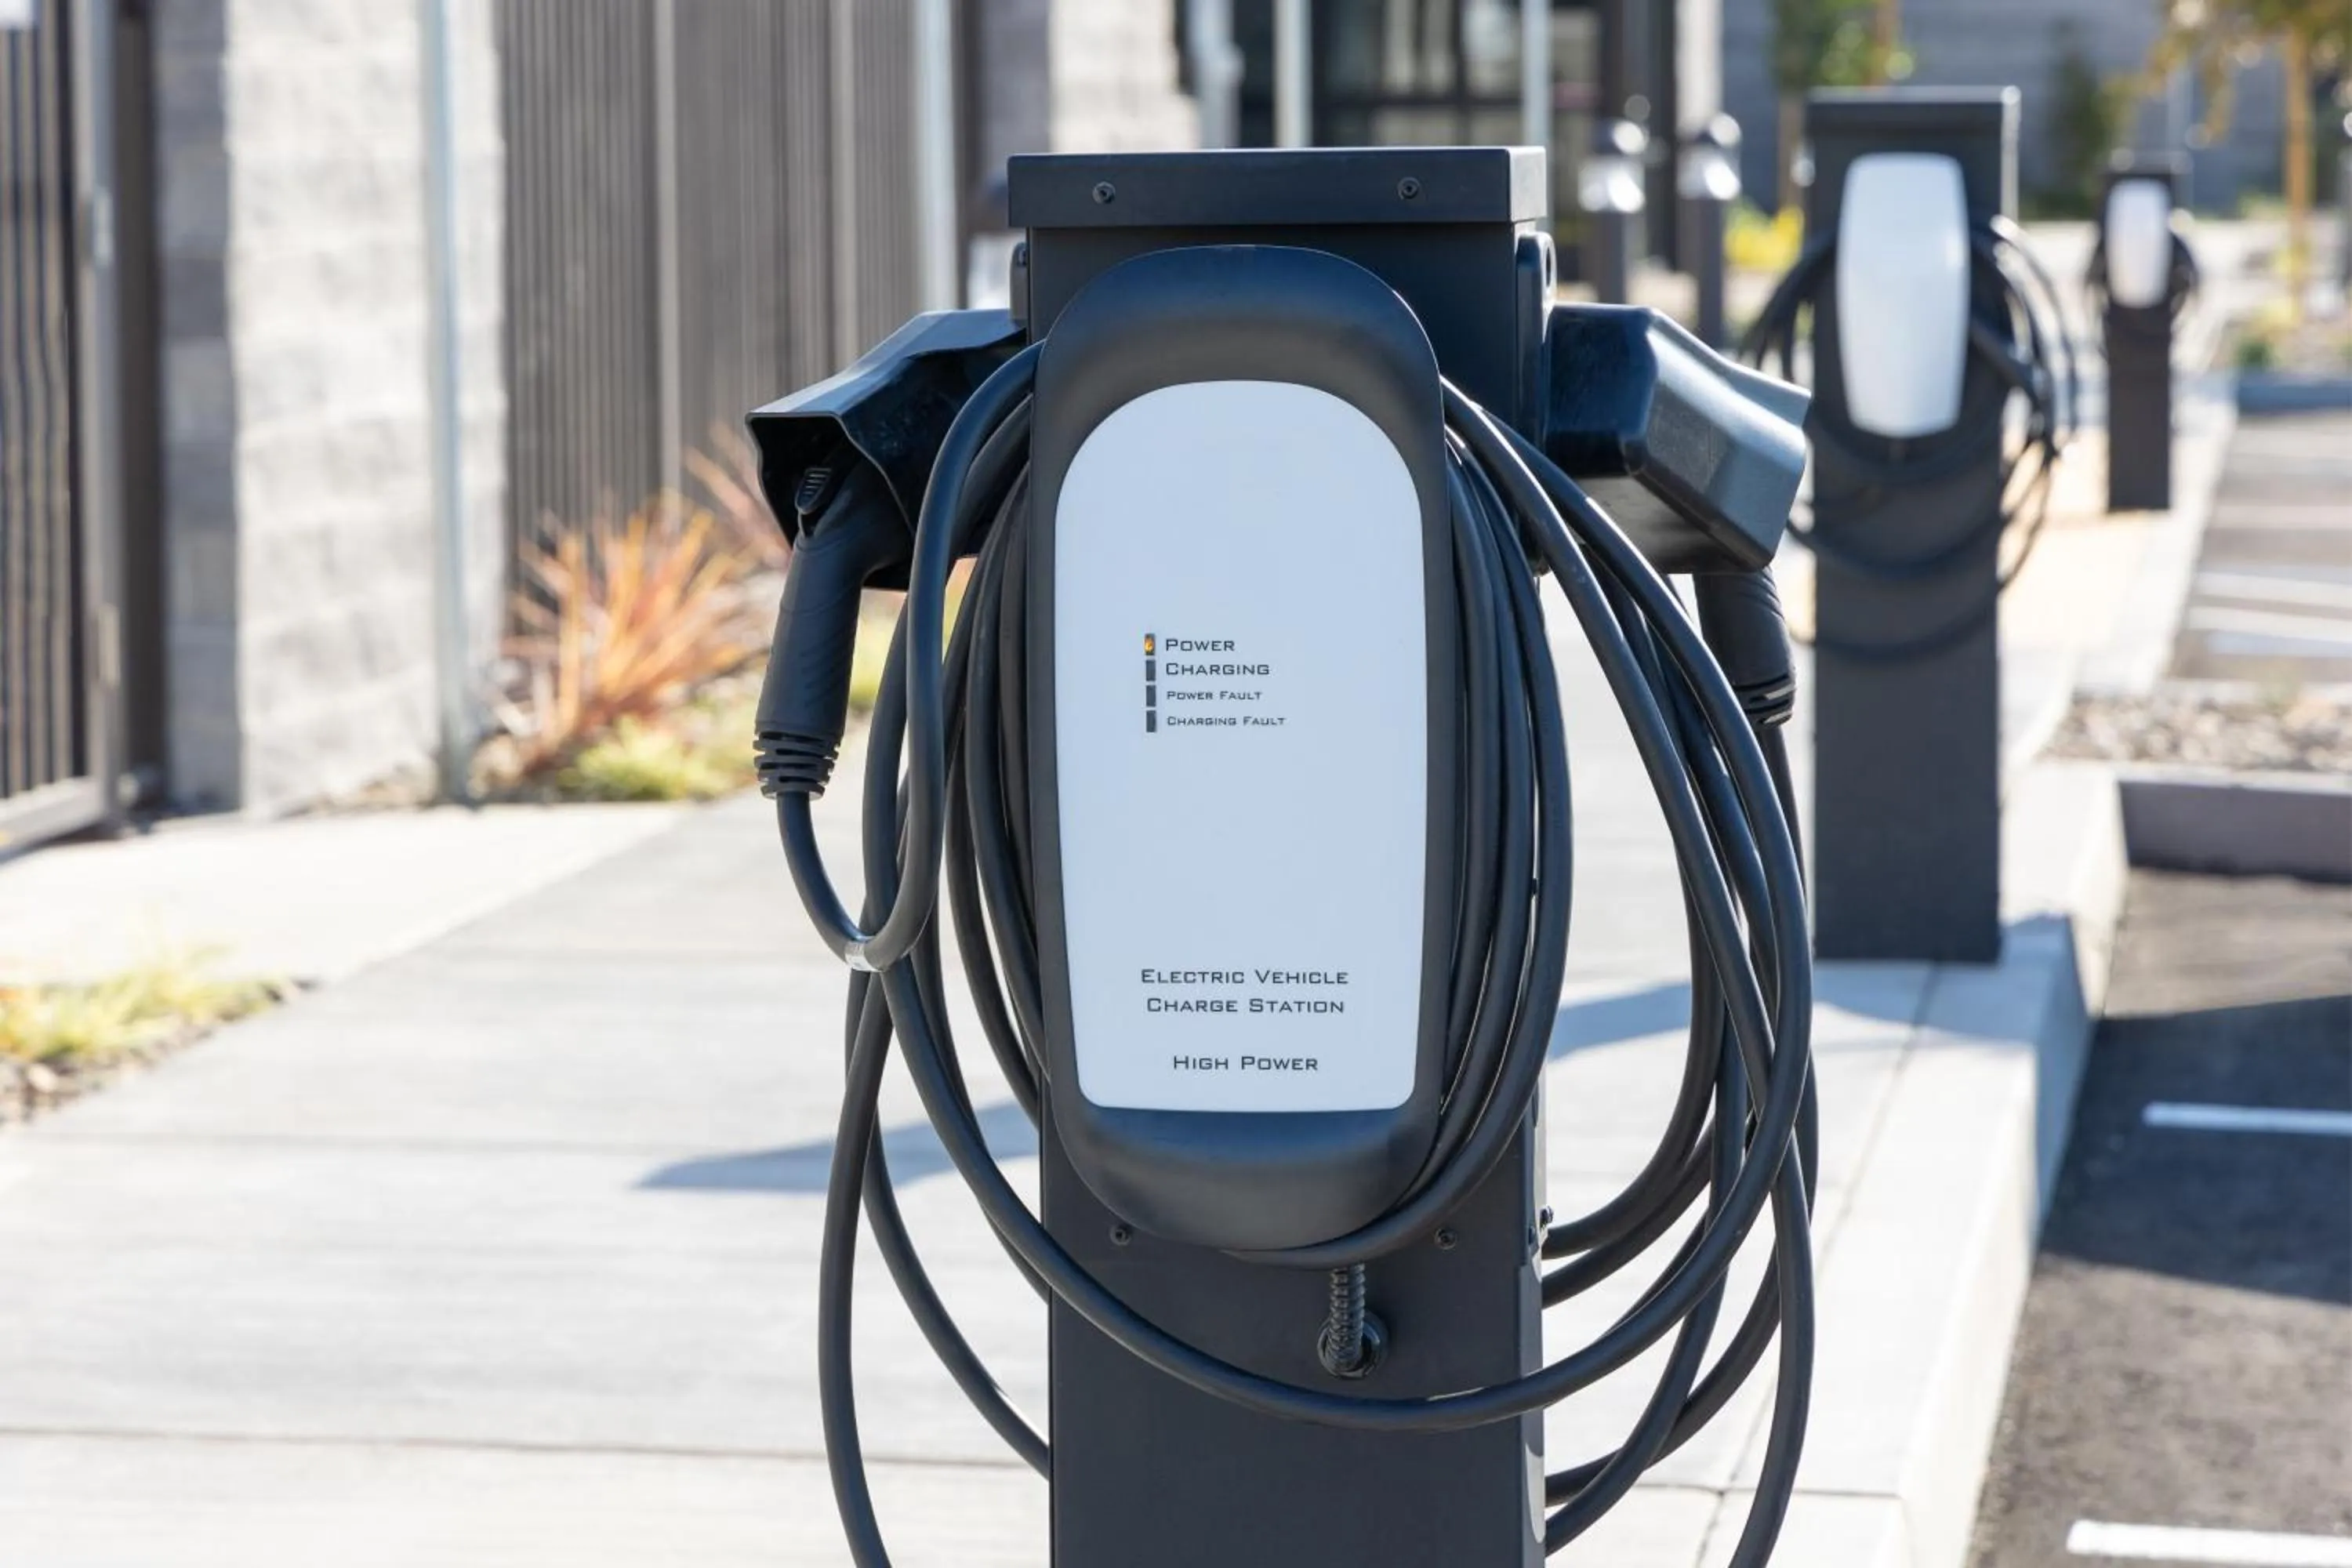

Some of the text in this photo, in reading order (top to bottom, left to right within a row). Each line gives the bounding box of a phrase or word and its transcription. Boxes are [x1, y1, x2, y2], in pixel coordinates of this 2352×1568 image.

[1166, 638, 1235, 652] POWER
[1166, 662, 1269, 676] CHARGING
[1167, 691, 1261, 700] POWER FAULT
[1167, 716, 1286, 726] CHARGING FAULT
[1141, 968, 1348, 985] ELECTRIC VEHICLE
[1147, 997, 1344, 1013] CHARGE STATION
[1173, 1055, 1318, 1070] HIGH POWER
